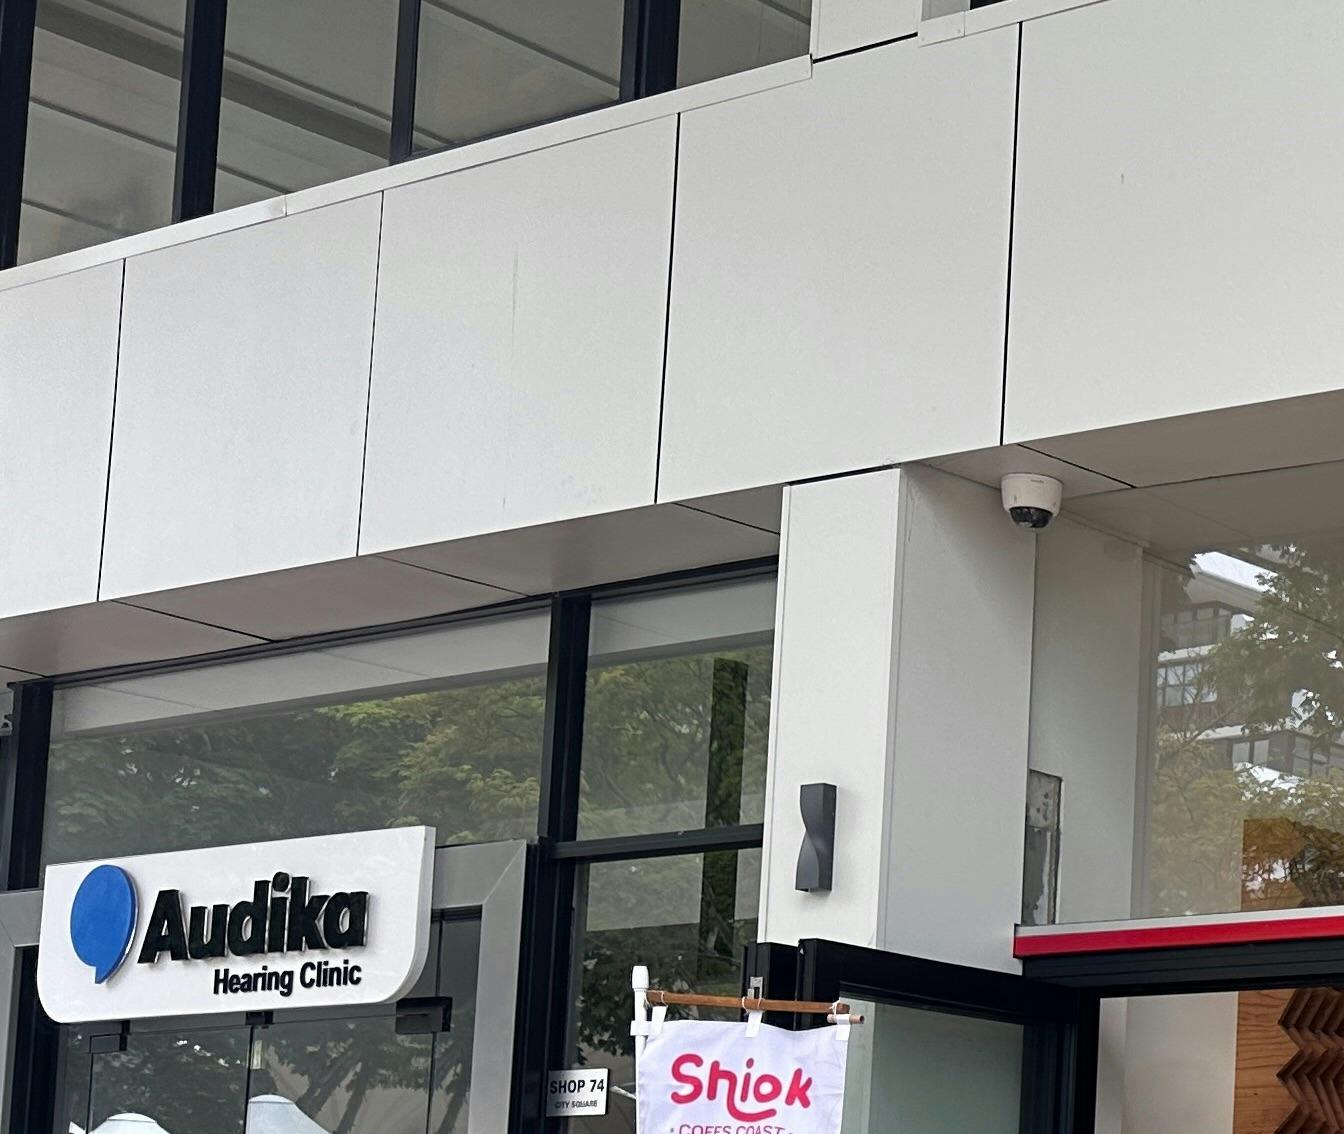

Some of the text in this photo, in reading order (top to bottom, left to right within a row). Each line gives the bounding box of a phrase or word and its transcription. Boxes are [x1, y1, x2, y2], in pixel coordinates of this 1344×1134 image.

[137, 871, 369, 964] Audika
[213, 959, 362, 997] Hearing Clinic
[550, 1079, 605, 1094] SHOP 74
[670, 1053, 813, 1122] Shiok
